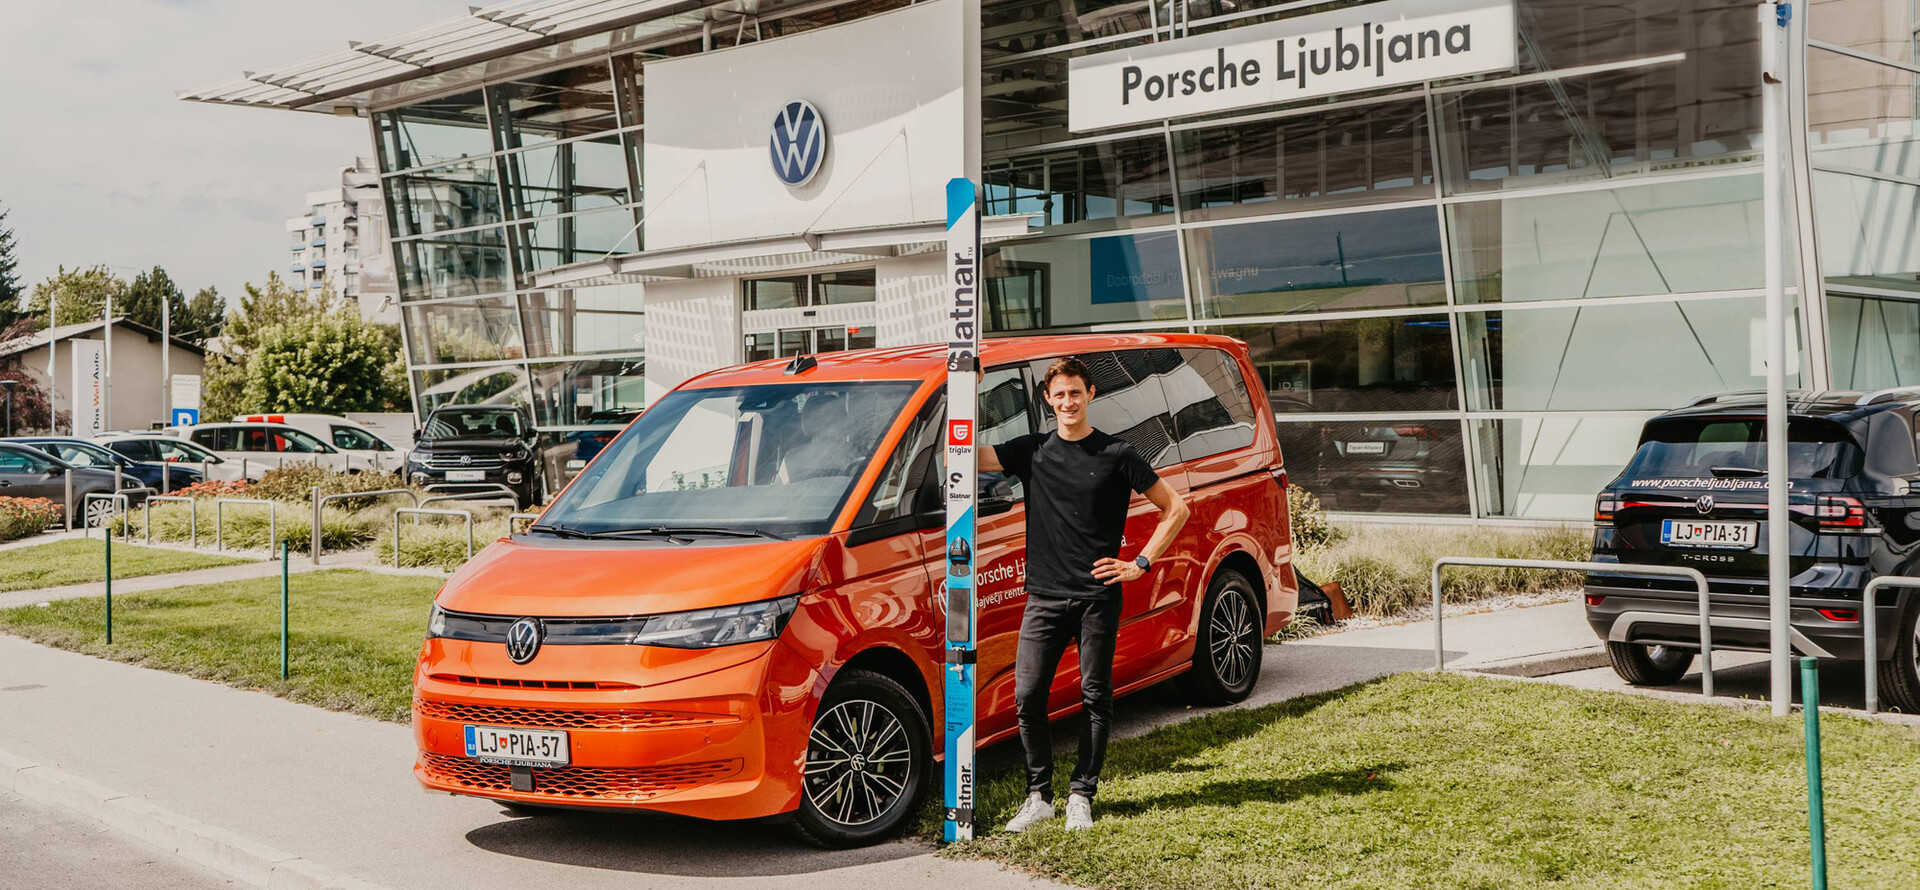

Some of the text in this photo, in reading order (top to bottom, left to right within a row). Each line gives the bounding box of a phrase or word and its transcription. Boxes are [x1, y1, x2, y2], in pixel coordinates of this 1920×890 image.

[1122, 21, 1471, 105] Porsche Ljubljana
[949, 446, 972, 455] triglav
[1631, 477, 1794, 490] www.porscheljubljana.cm
[1676, 523, 1693, 540] LJ
[1682, 554, 1735, 563] T-CROSS
[976, 562, 1014, 586] orsche
[1004, 587, 1027, 600] cente
[480, 731, 498, 753] LJ
[480, 757, 553, 769] PORSCHE LJUBLJANA
[958, 765, 972, 829] Satnar
